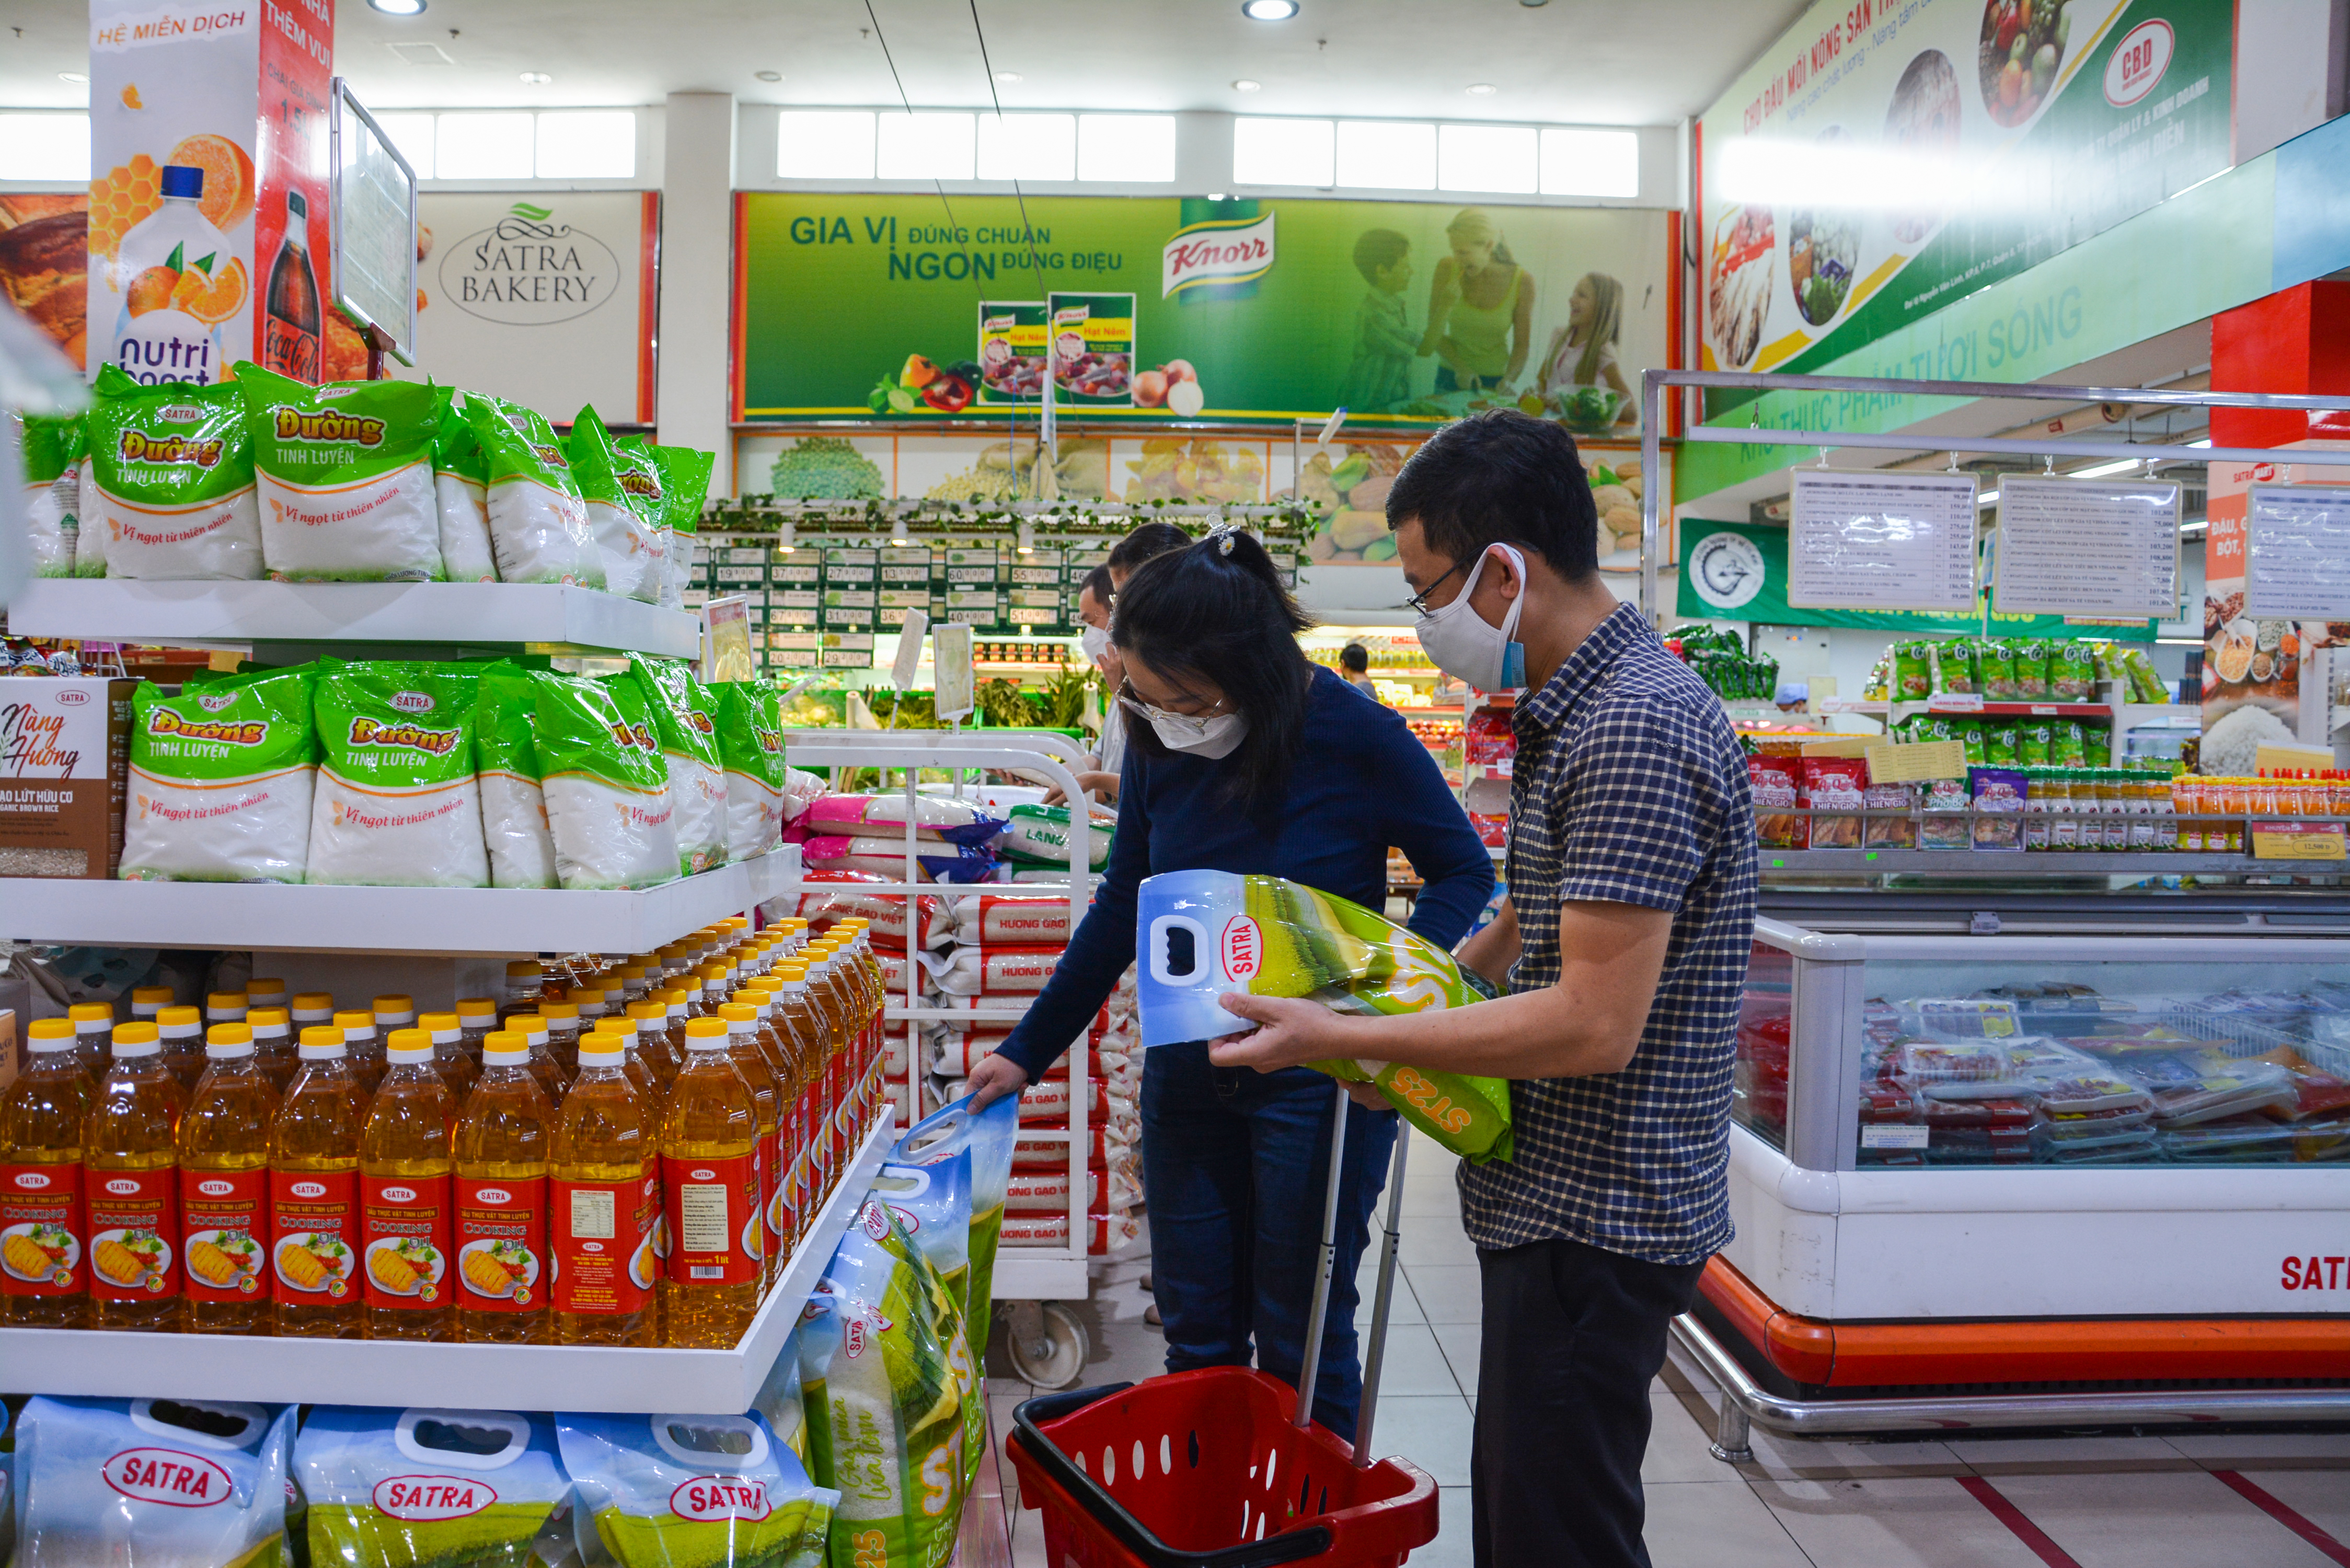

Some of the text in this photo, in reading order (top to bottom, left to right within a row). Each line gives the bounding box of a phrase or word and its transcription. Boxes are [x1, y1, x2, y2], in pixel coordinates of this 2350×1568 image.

[97, 23, 128, 46] HỆ
[193, 11, 246, 34] DỊCH
[264, 0, 330, 70] THÊM VUI
[1811, 23, 1841, 77] NÔNG
[2122, 38, 2152, 81] CBD
[790, 216, 854, 246] GIA
[864, 216, 897, 250] VỊ
[908, 223, 969, 245] ĐÚNG
[474, 243, 582, 271] SATRA
[888, 248, 1122, 281] NGON ĐÚNG ĐIỆU
[1166, 237, 1269, 276] Knorr
[461, 276, 597, 303] BAKERY
[1084, 326, 1126, 337] Hạt Nêm
[1987, 284, 2083, 371] SỐNG
[120, 338, 210, 368] nutri
[322, 388, 351, 398] SATRA
[165, 408, 195, 419] SATRA
[277, 407, 385, 446] Đường
[123, 431, 224, 467] Đường
[277, 448, 354, 467] TINH LUYỆN
[117, 469, 191, 487] TINH LUYỆN
[286, 487, 399, 526] Vị ngọt từ thiên nhiên
[123, 513, 233, 546] Vị ngọt từ thiên nhiên
[2216, 538, 2241, 558] BỘT,
[204, 694, 235, 710] SATRA
[396, 696, 430, 708] SATRA
[2, 703, 67, 748] Nàng
[153, 709, 266, 744] Đường
[352, 716, 458, 755] Đường
[2, 733, 83, 783] Hương
[149, 742, 230, 762] TINH LUYỆN
[346, 752, 427, 769] TINH LUYỆN
[0, 788, 73, 803] ẠO LỨT HỮU CƠ
[151, 792, 269, 822] Vị ngọt từ thiên nhiên
[346, 798, 464, 828] Vị ngọt từ thiên nhiên
[632, 806, 644, 823] Vị
[1026, 827, 1066, 846] LÀNG
[878, 910, 905, 925] VIỆT
[1232, 924, 1254, 975] SATRA
[1388, 1066, 1472, 1135] ST25
[203, 1183, 227, 1192] SATRA
[296, 1185, 321, 1194] SATRA
[386, 1190, 411, 1198] SATRA
[481, 1192, 505, 1201] SATRA
[3, 1208, 67, 1219] COOKING
[94, 1213, 157, 1225] COOKING
[188, 1214, 251, 1226] COOKING
[279, 1216, 342, 1228] COOKING
[370, 1221, 432, 1233] COOKING
[463, 1223, 526, 1235] COOKING
[715, 1255, 719, 1264] 1
[720, 1255, 729, 1264] lít
[2280, 1256, 2350, 1290] SAT
[122, 1458, 210, 1499] SATRA
[389, 1483, 473, 1509] SATRA
[688, 1485, 761, 1515] SATRA
